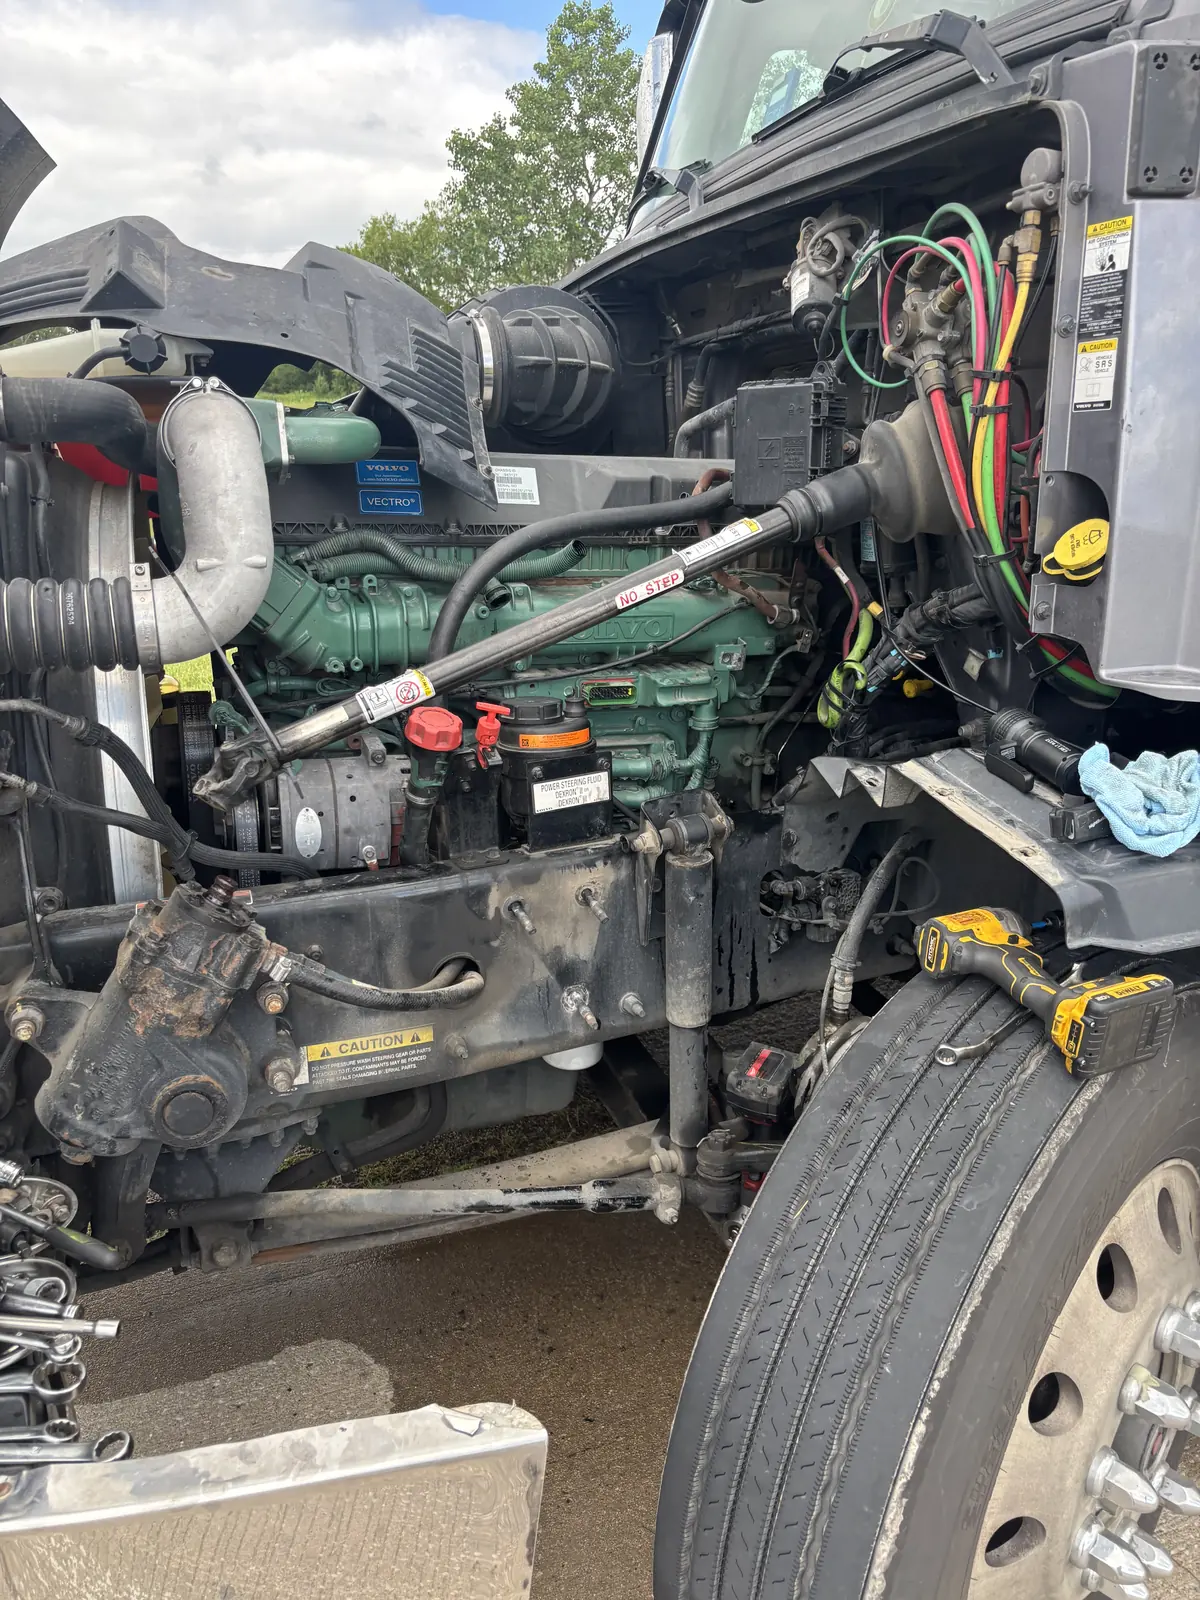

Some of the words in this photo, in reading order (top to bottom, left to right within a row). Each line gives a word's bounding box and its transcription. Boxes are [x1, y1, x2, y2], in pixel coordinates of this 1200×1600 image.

[1100, 219, 1126, 230] CAUTION
[1090, 342, 1112, 350] CAUTION
[620, 590, 638, 606] NO
[646, 572, 680, 596] STEP
[540, 782, 560, 792] POWER
[560, 778, 586, 789] STEERING
[588, 774, 602, 784] FLUID
[338, 1034, 404, 1054] CAUTION
[331, 1060, 356, 1068] PRESSURE
[372, 1054, 395, 1062] STEERING
[352, 1062, 389, 1071] CONTAMINANTS
[352, 1070, 377, 1079] DAMAGING
